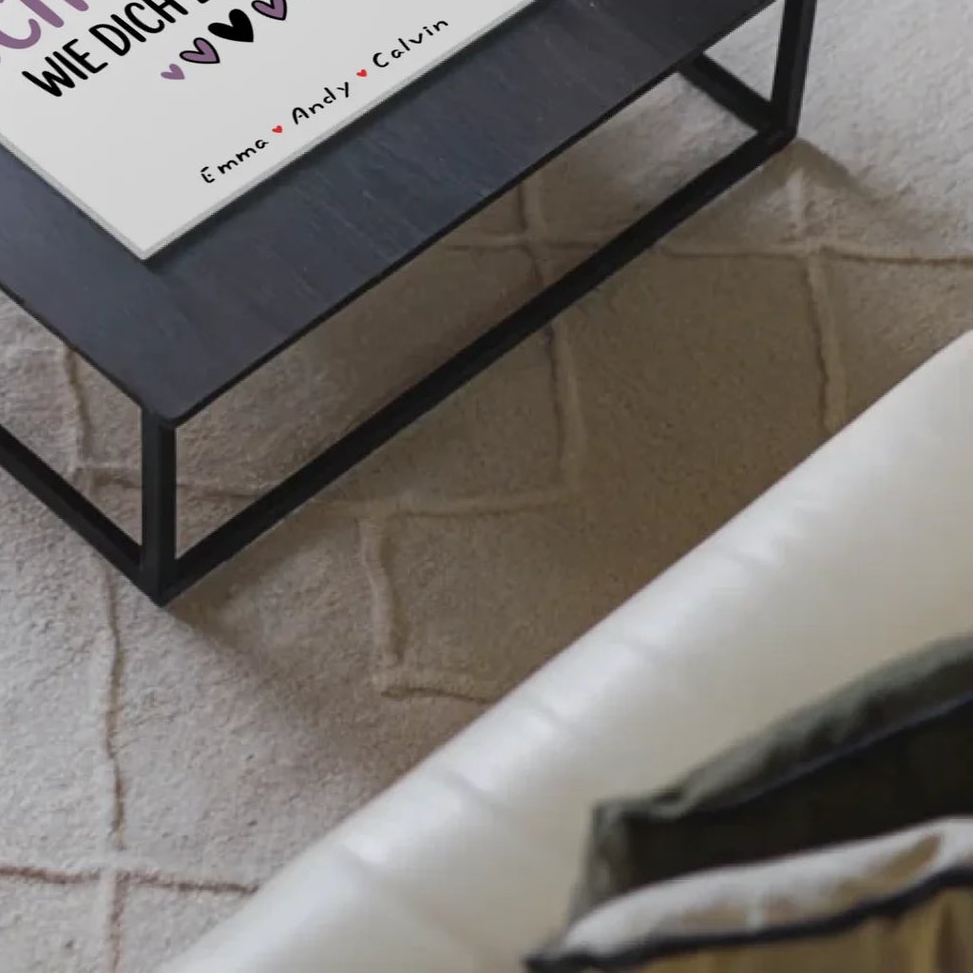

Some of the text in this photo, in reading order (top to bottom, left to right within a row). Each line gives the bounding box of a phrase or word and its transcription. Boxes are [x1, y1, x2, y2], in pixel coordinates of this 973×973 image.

[21, 38, 109, 98] WIE
[200, 20, 449, 184] Emma Andy Calvin
